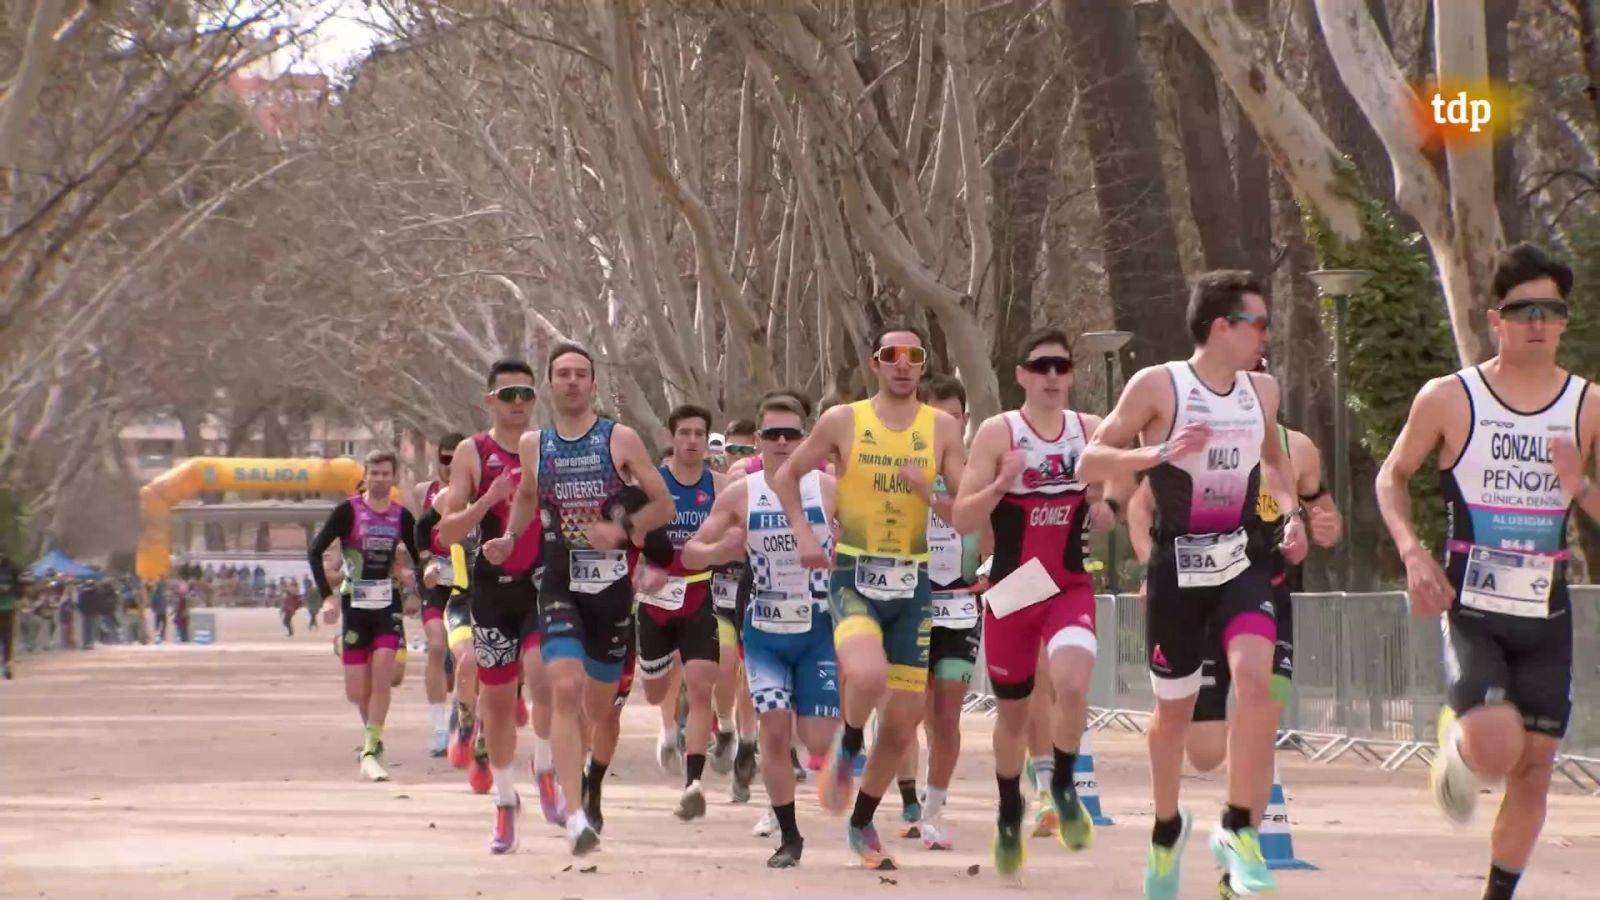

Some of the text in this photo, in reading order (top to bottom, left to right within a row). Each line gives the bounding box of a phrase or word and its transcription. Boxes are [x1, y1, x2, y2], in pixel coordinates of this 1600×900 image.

[1491, 432, 1552, 463] GONZALE
[1207, 447, 1240, 470] MALO
[234, 466, 309, 481] SALIDA
[1483, 464, 1561, 492] PEÑOTA
[554, 479, 608, 500] GUTIÉRREZ
[1256, 493, 1279, 515] STAS
[760, 509, 816, 528] FERL
[1030, 502, 1072, 527] GÓMEZ
[763, 534, 798, 553] COREN
[1179, 554, 1216, 568] 33A
[573, 566, 601, 579] 21A
[859, 570, 887, 587] 12A
[1471, 569, 1496, 591] 1A
[757, 604, 781, 618] 10A
[814, 704, 840, 718] FER
